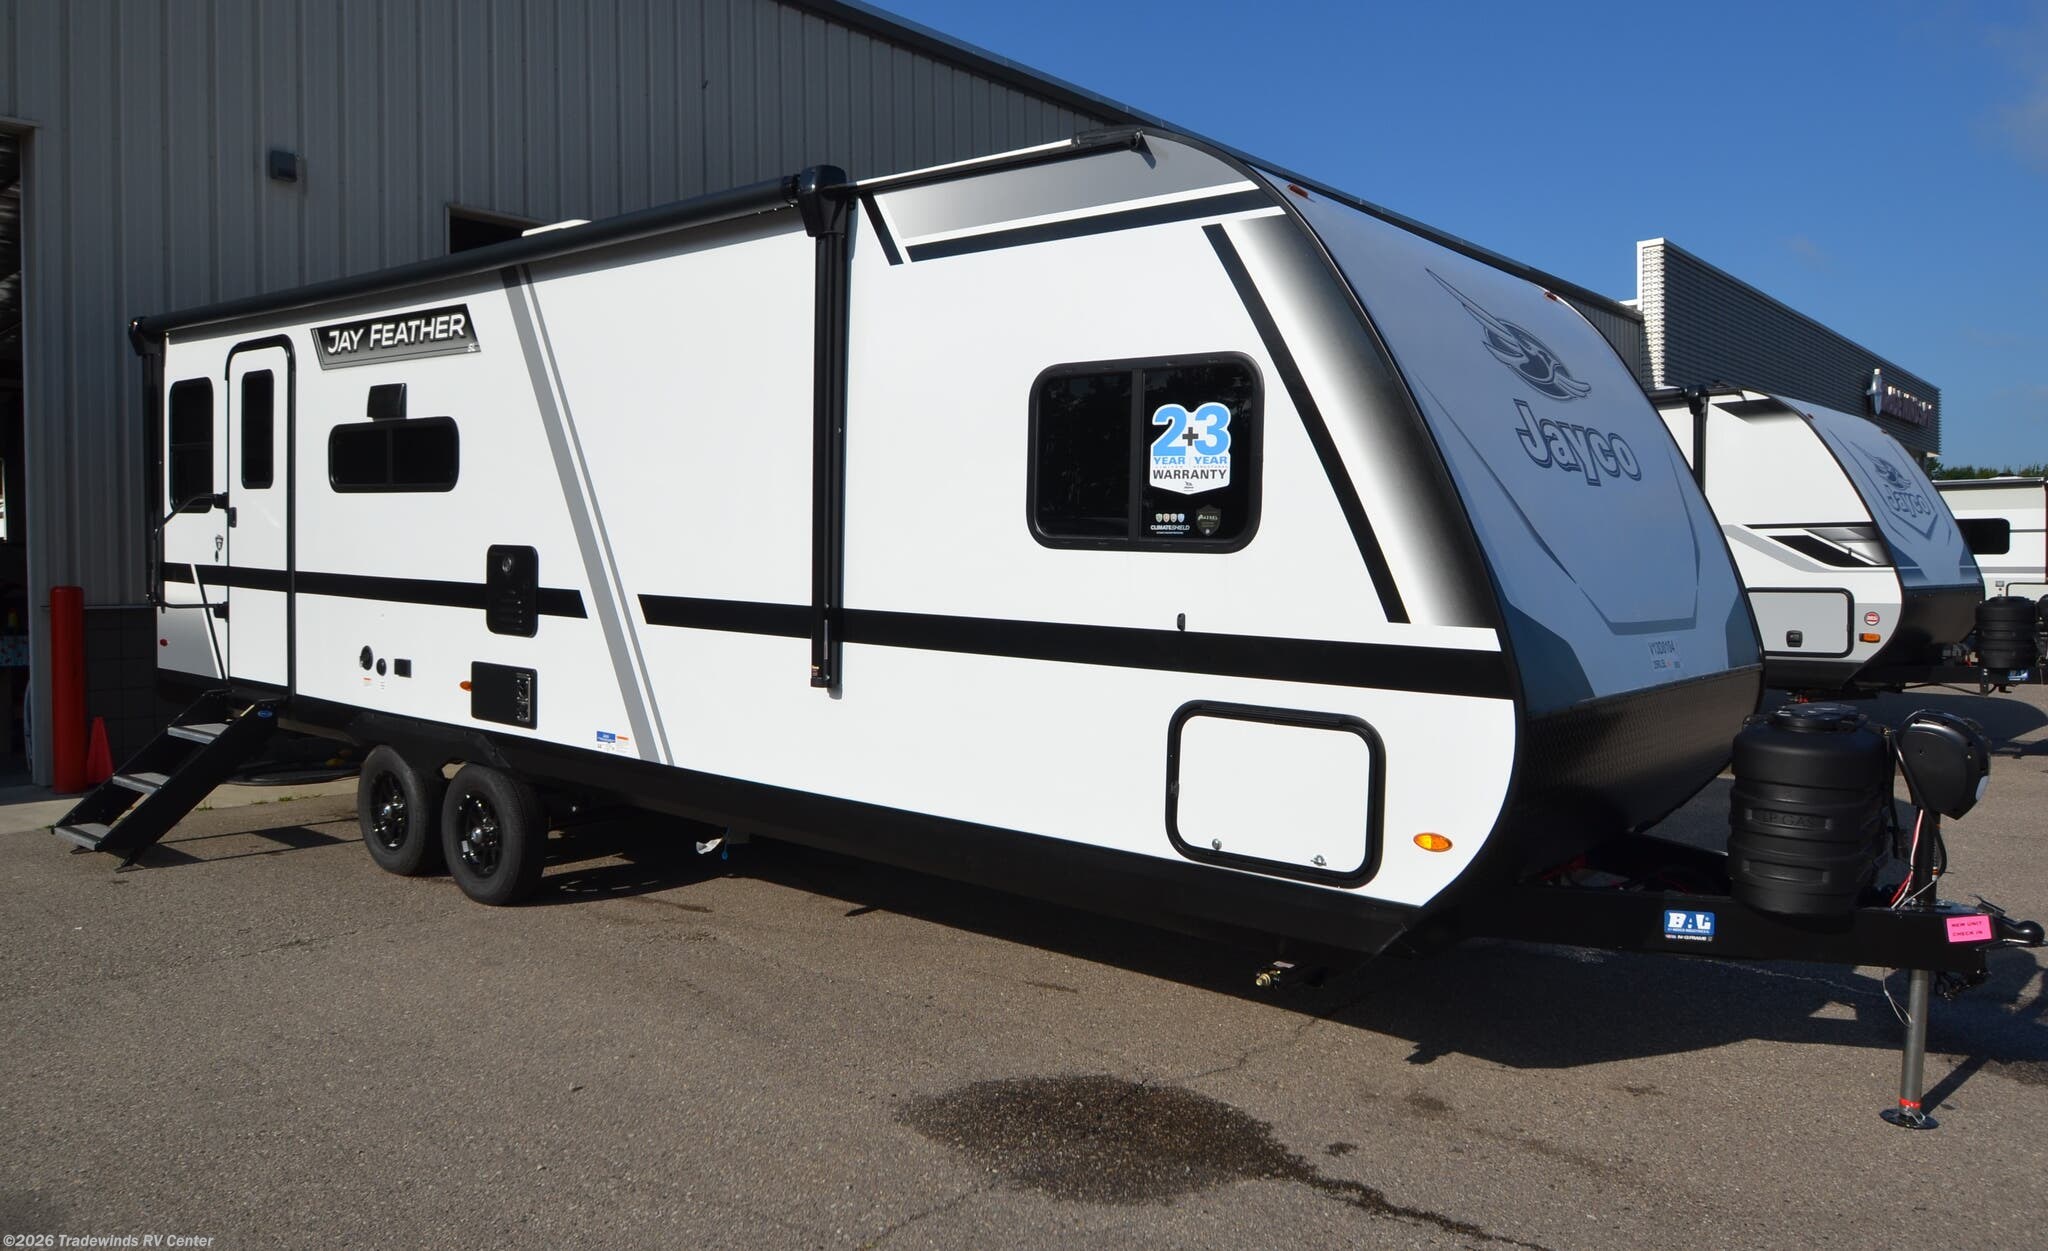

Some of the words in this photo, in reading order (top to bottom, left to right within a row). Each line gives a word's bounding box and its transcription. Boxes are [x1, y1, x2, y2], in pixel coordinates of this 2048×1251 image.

[328, 329, 364, 354] JAY
[369, 314, 466, 348] FEATHER
[1513, 398, 1641, 486] Jayco
[1153, 457, 1186, 465] YEAR
[1194, 457, 1228, 465] YEAR
[1153, 469, 1227, 479] WARRANTY
